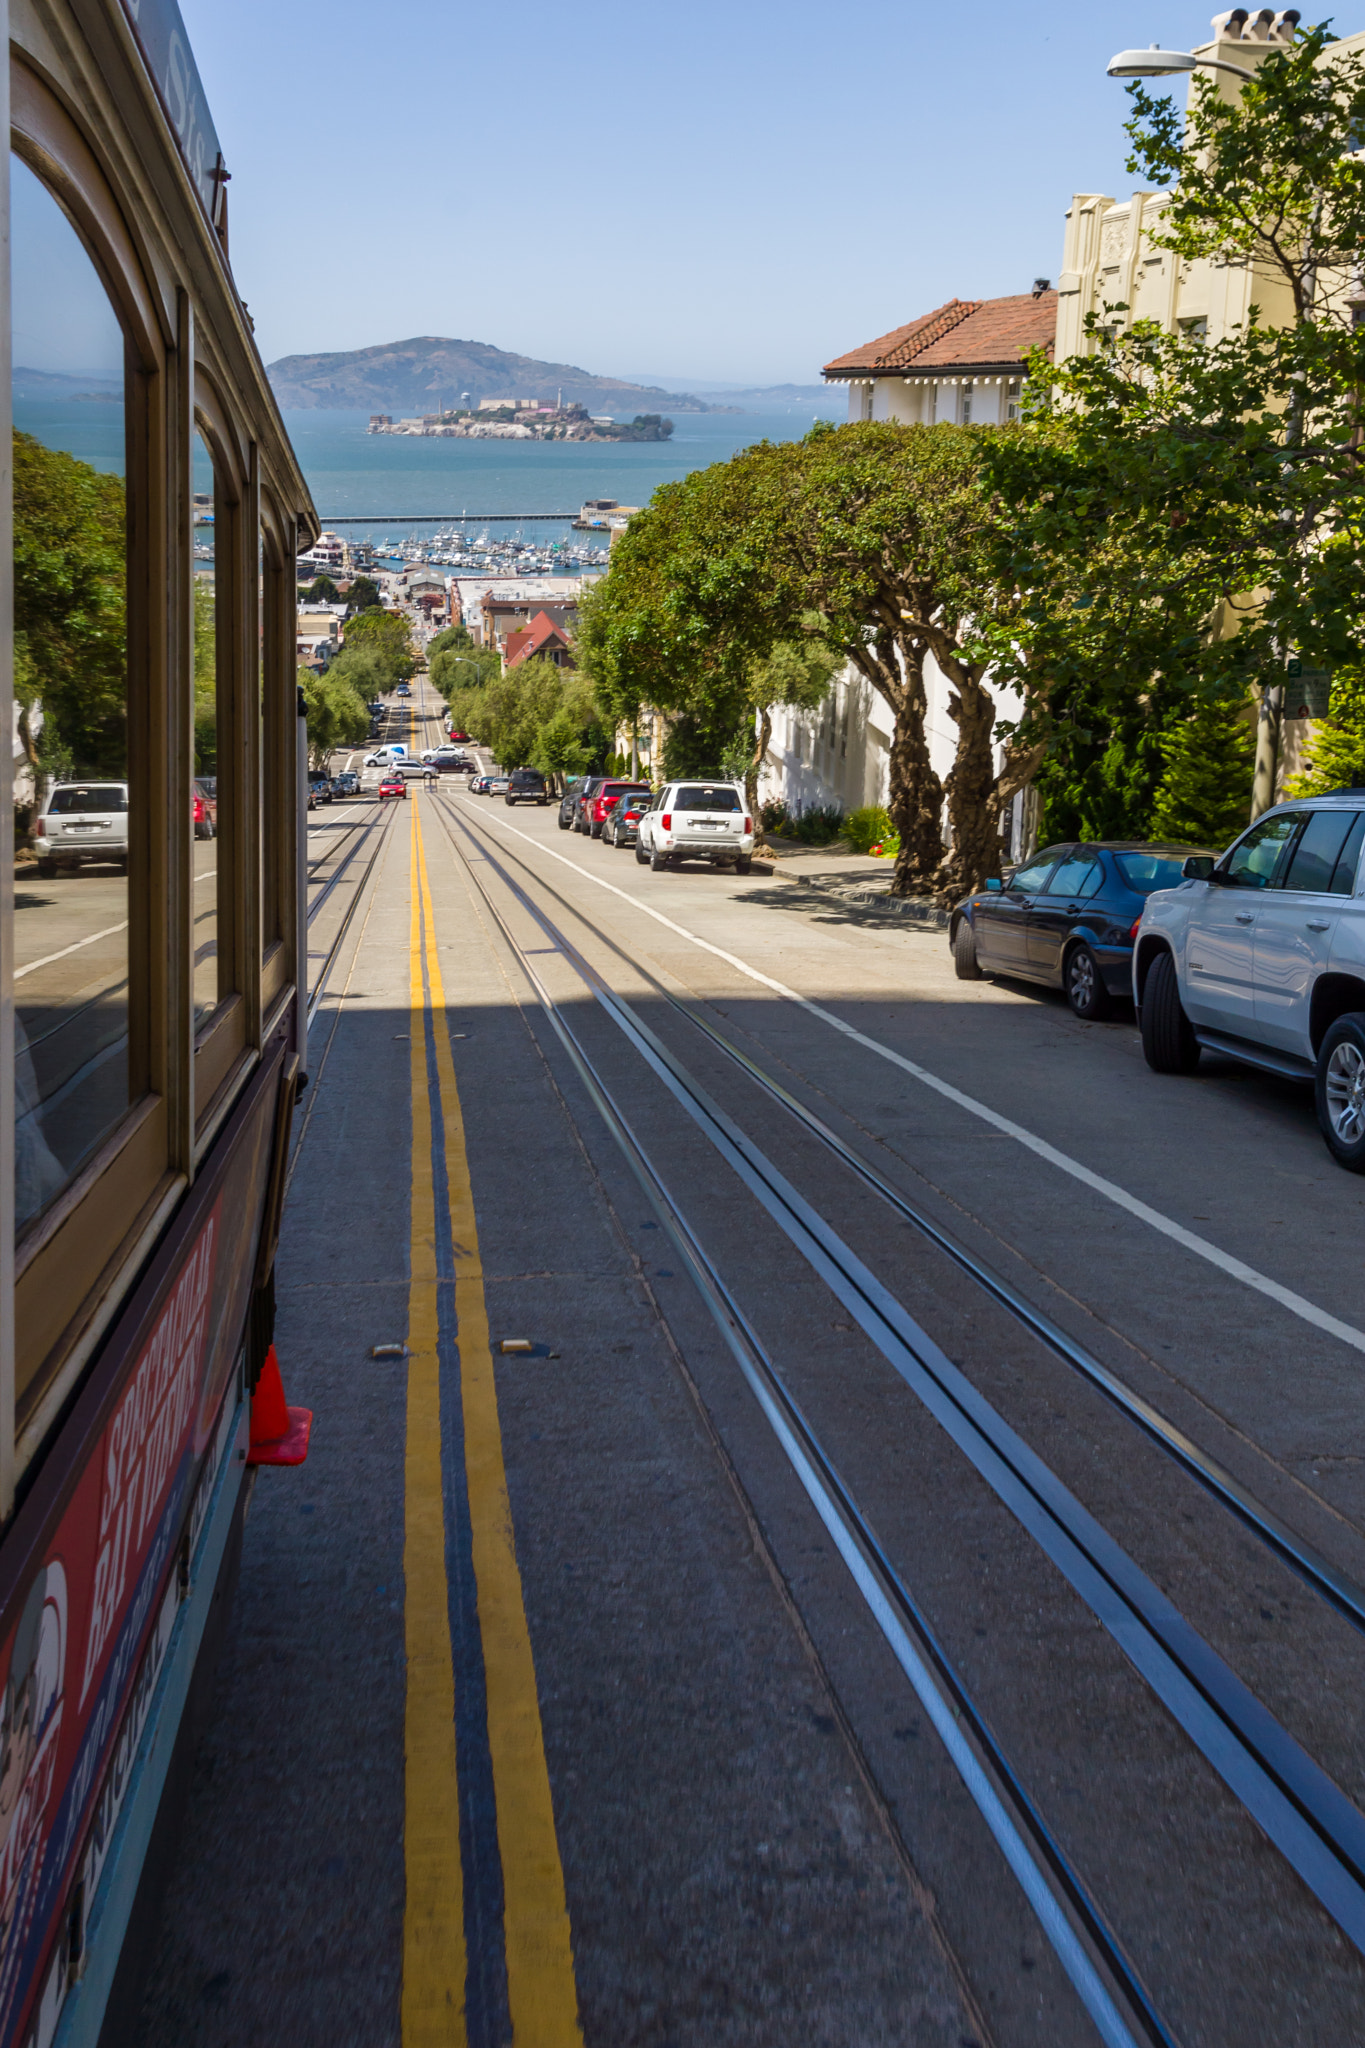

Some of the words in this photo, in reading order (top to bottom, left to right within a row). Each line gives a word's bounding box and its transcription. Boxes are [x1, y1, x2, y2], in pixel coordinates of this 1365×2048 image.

[1290, 661, 1300, 674] 2
[77, 1460, 142, 1716] BAY
[137, 1303, 206, 1554] VIEWS!
[98, 1217, 214, 1546] SPECTACULAR
